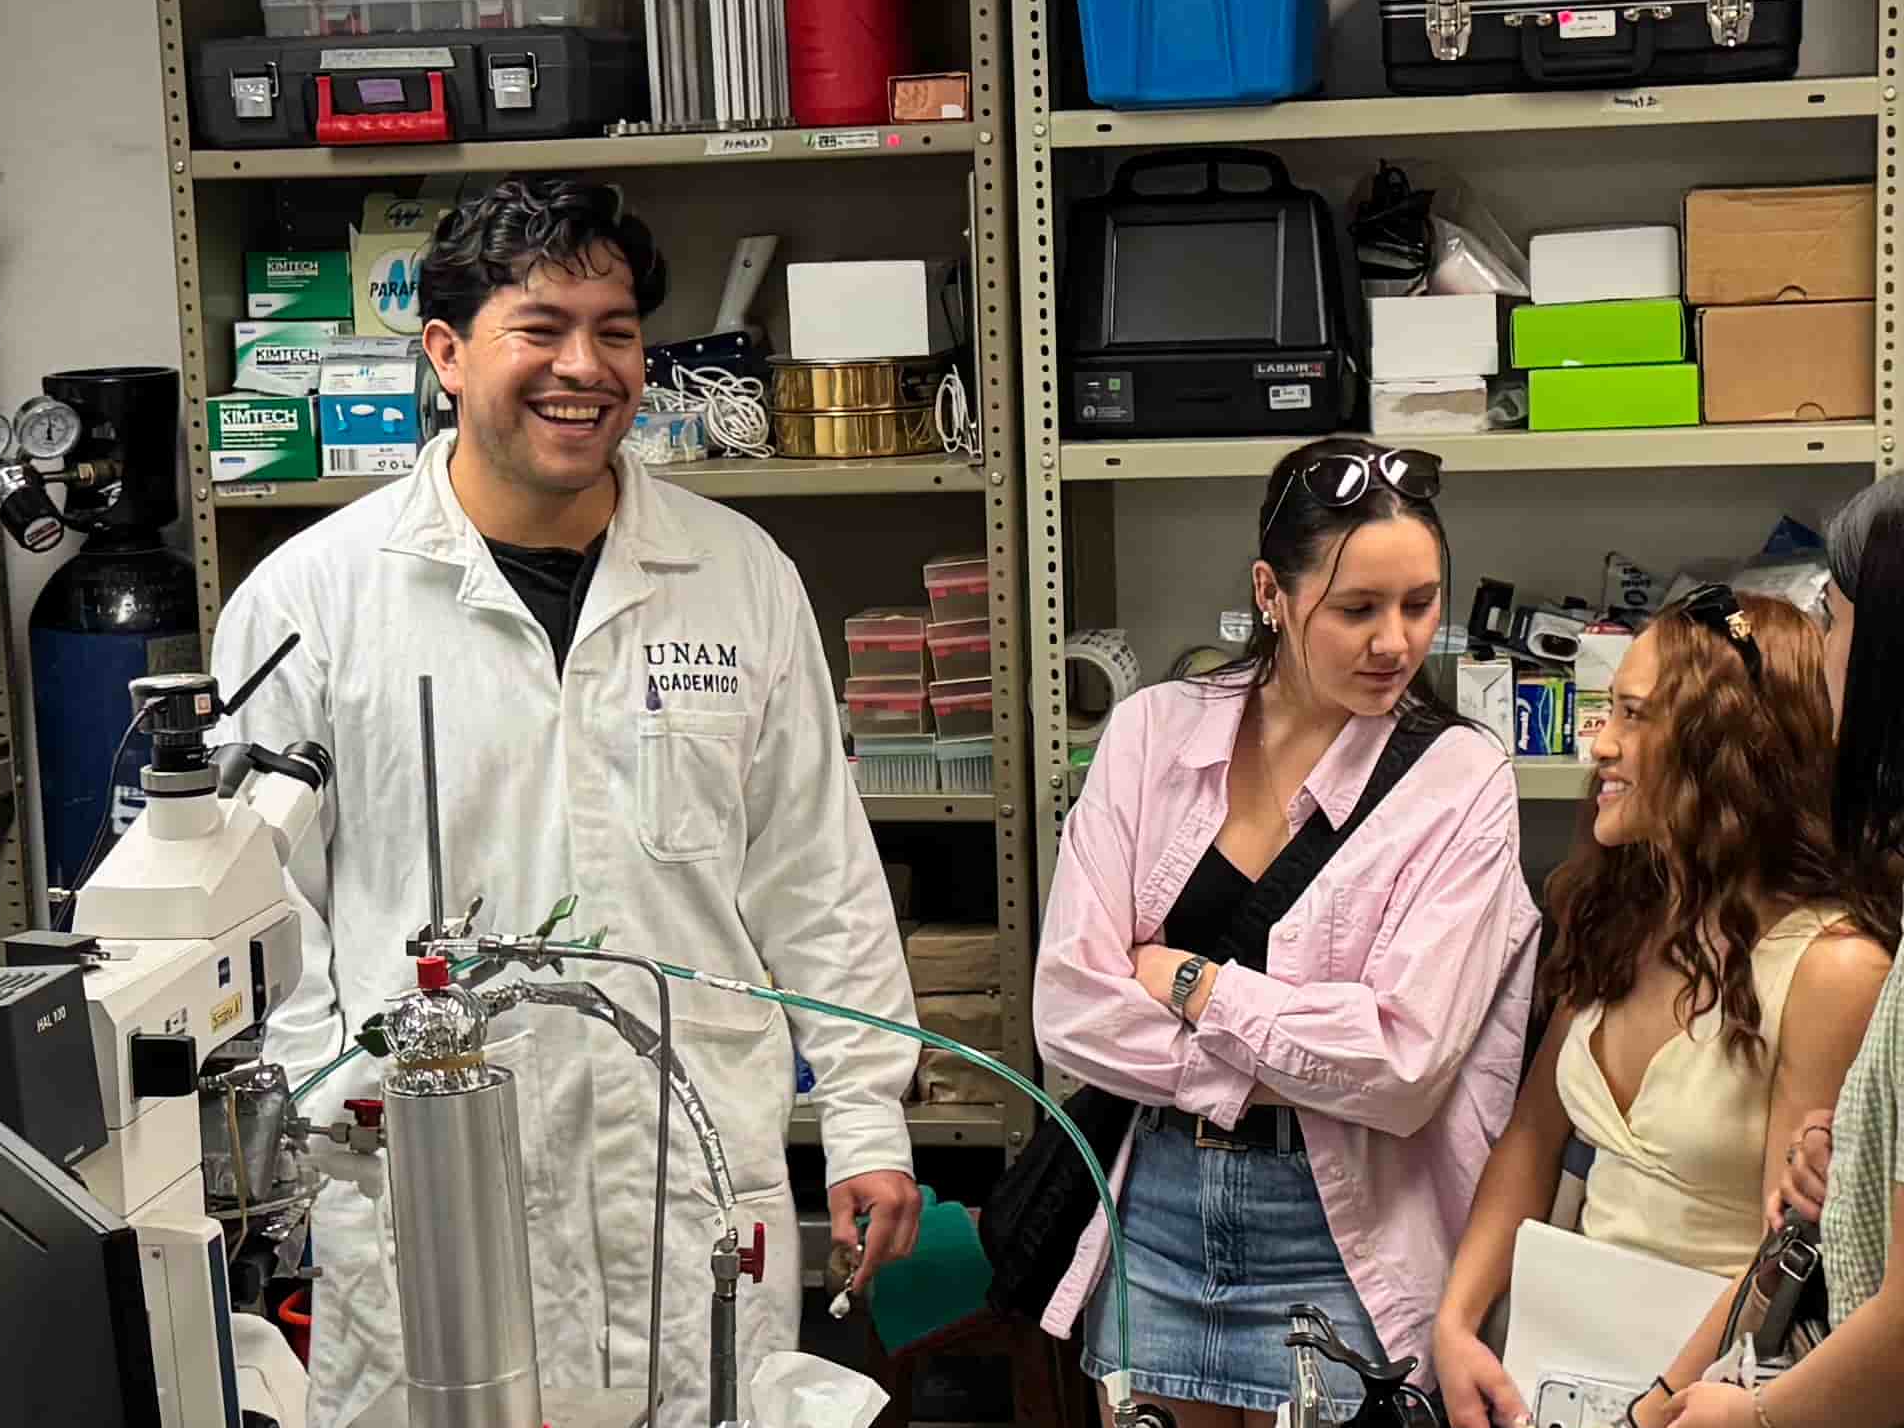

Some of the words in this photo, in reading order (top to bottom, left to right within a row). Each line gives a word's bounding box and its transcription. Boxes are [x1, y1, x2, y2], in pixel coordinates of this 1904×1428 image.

[266, 260, 319, 272] KIMTECH
[369, 282, 423, 298] PARAF
[255, 346, 321, 363] KIMTECH
[220, 408, 298, 425] KIMTECH
[644, 642, 737, 667] UNAM
[648, 673, 739, 694] ACADEMICO
[36, 1012, 53, 1033] HAL
